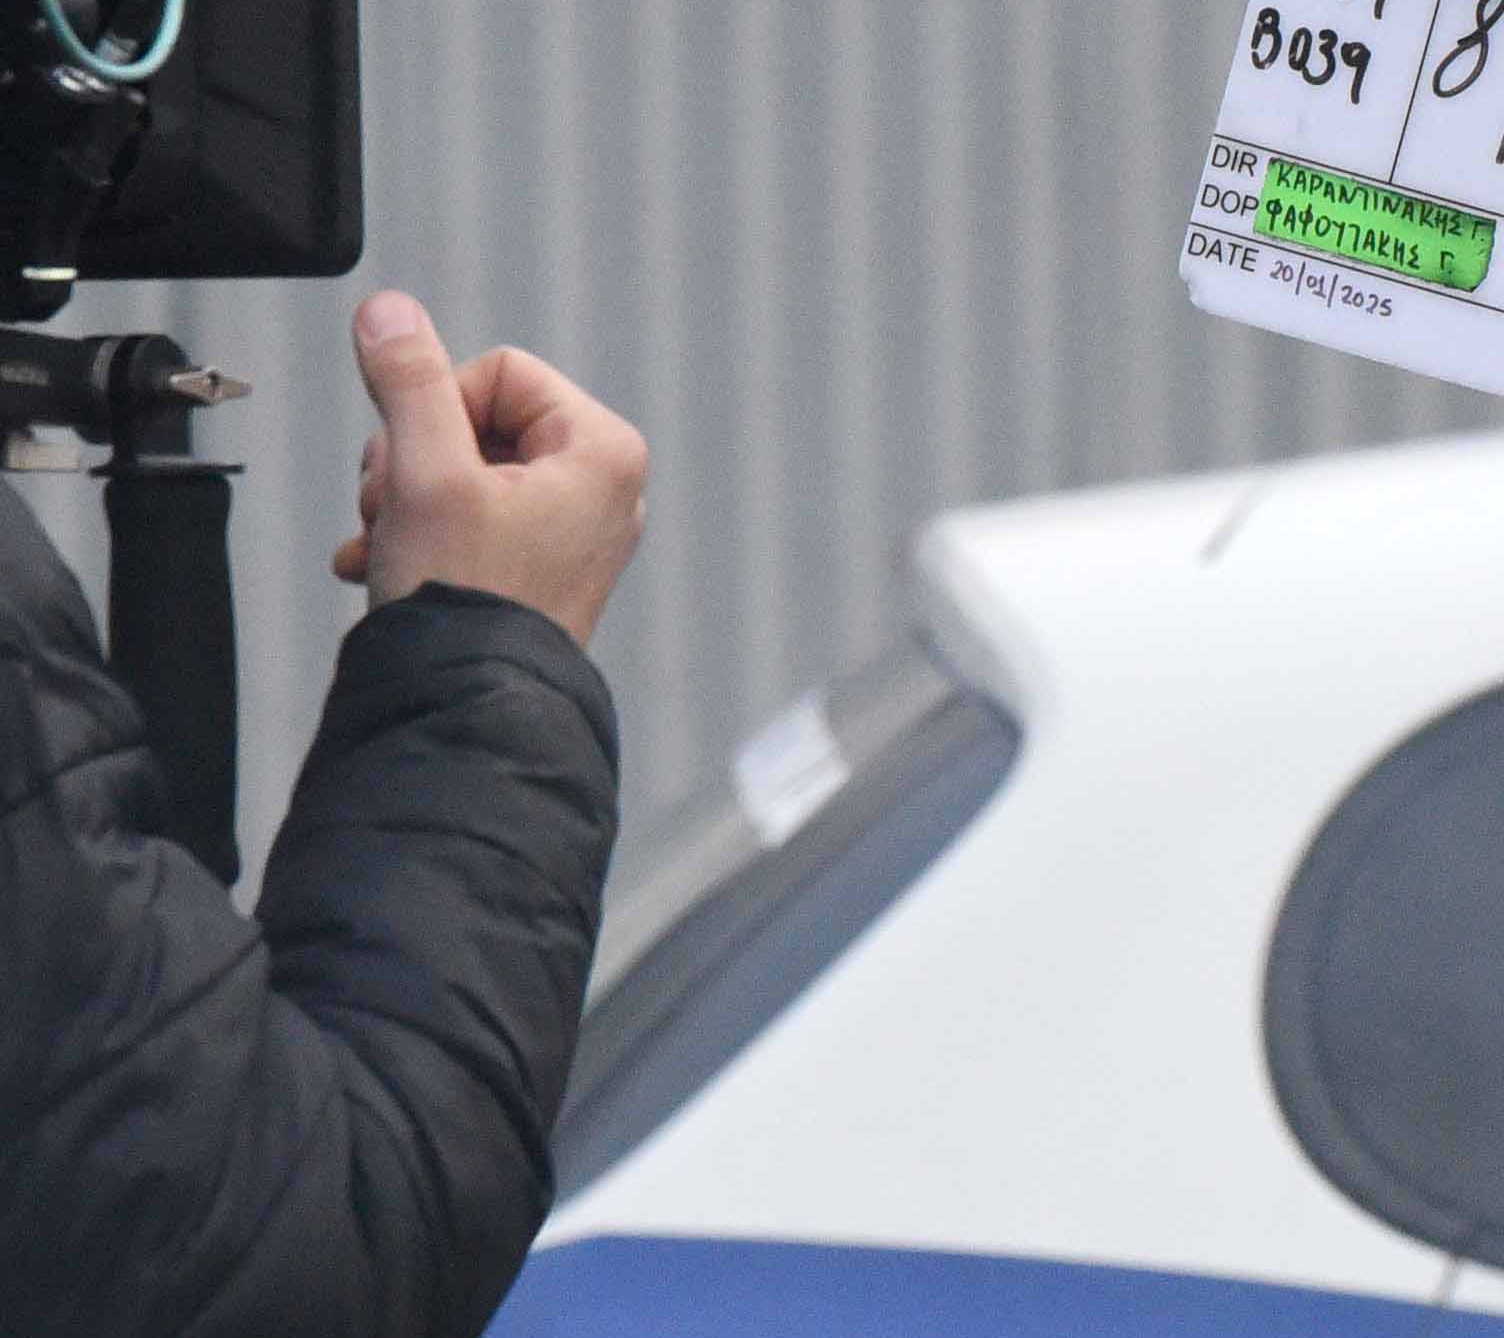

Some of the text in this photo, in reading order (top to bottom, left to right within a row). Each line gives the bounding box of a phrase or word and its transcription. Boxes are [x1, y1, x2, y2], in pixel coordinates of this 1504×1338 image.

[1251, 7, 1371, 104] B039
[1211, 144, 1258, 177] DIR
[1200, 184, 1259, 217] DOP
[1188, 232, 1259, 272] DATE
[1270, 261, 1392, 317] 20/01/2025
